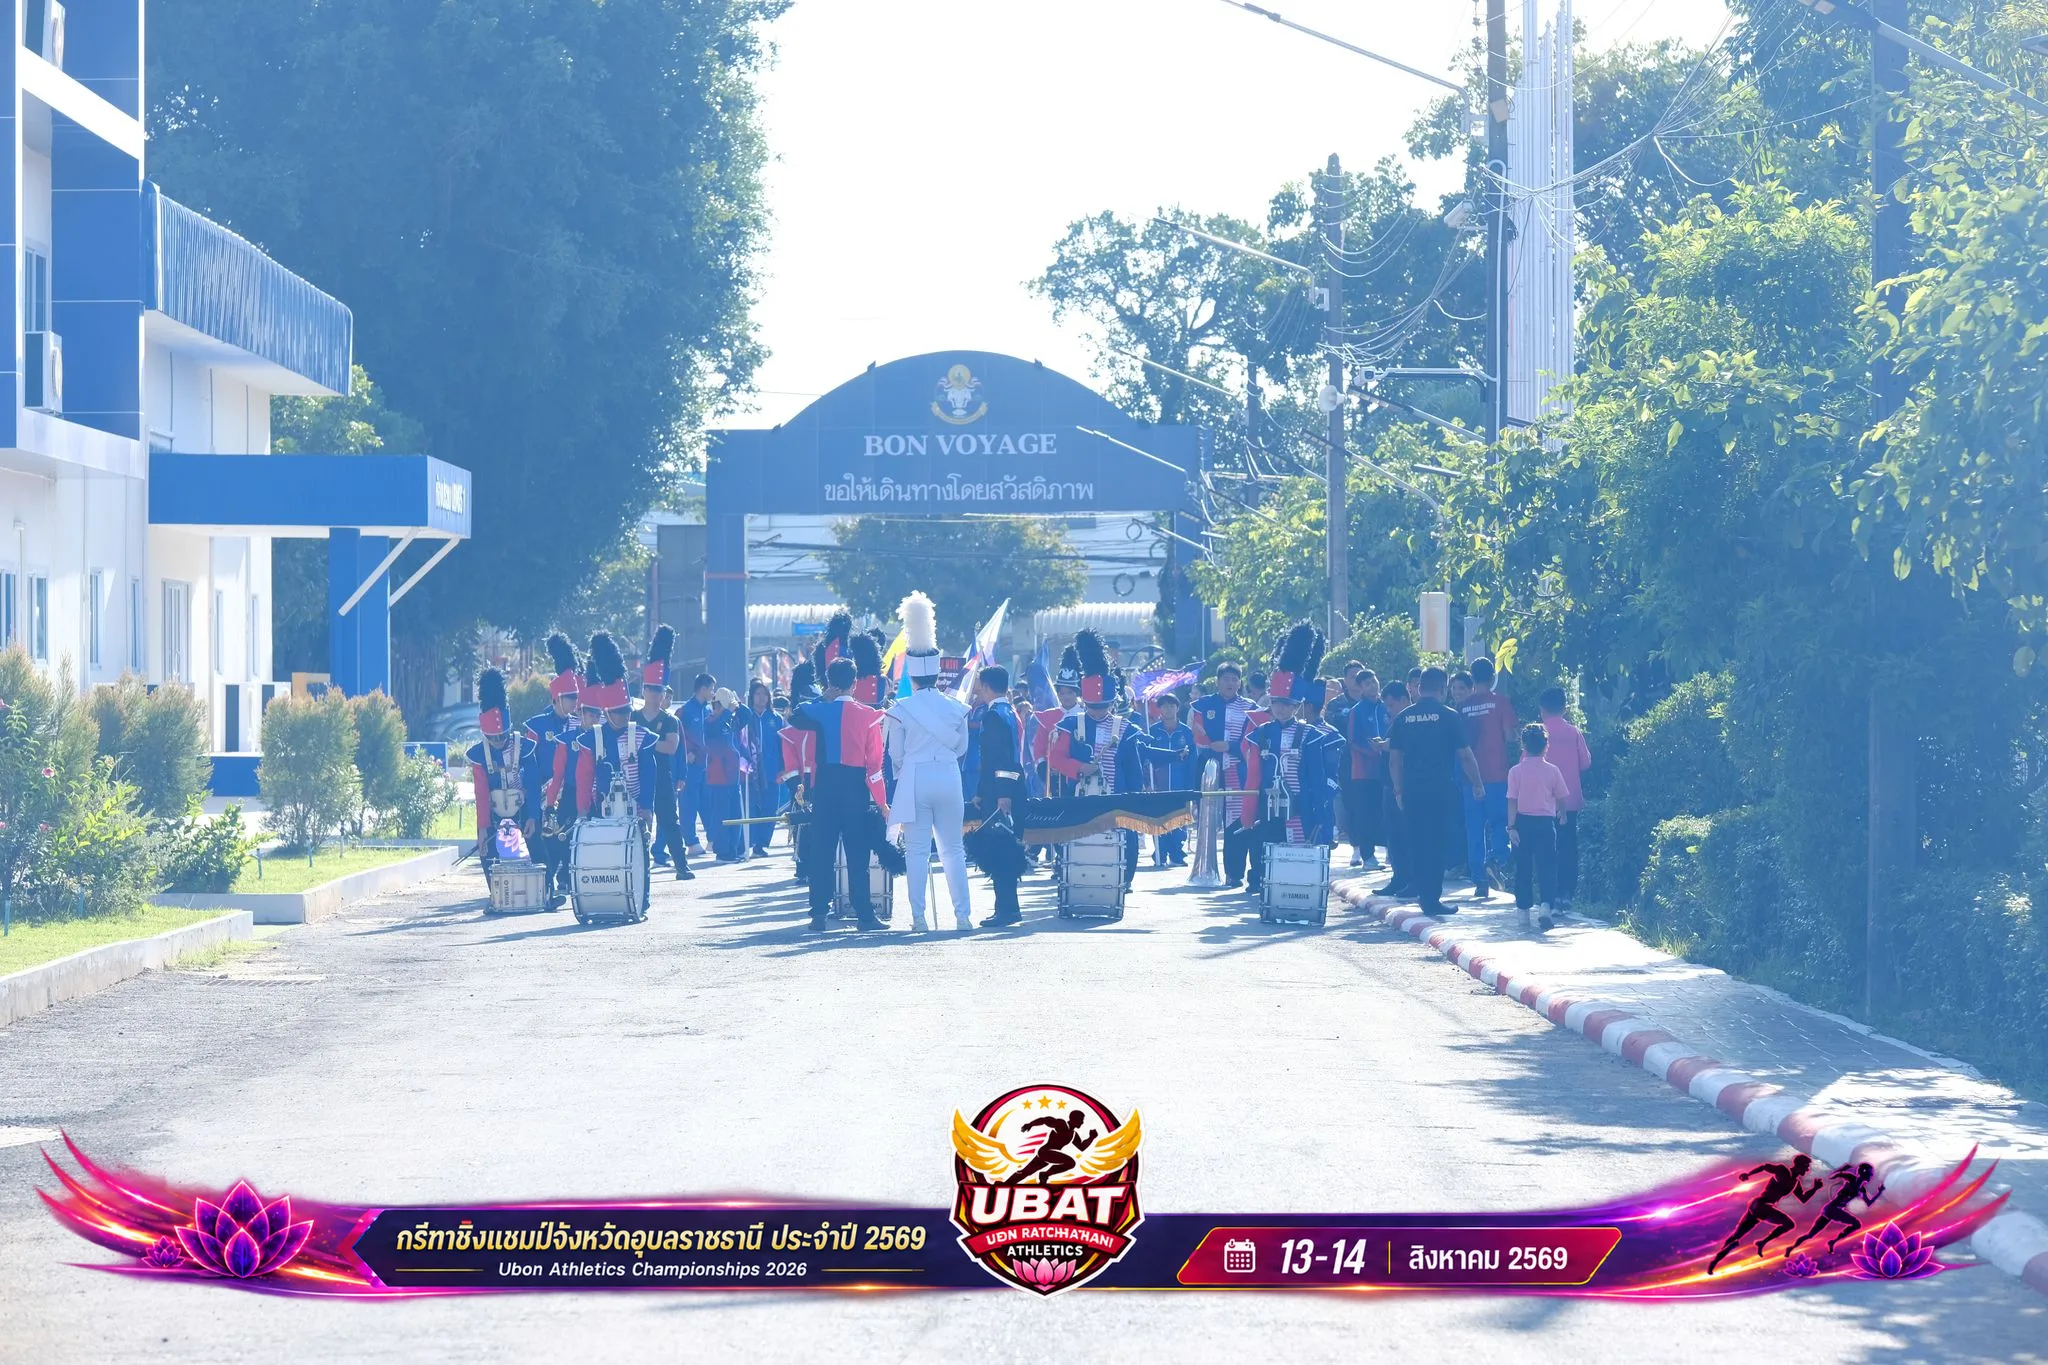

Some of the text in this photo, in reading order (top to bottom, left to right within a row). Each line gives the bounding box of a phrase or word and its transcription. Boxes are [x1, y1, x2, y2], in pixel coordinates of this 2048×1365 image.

[864, 433, 1057, 457] BON VOYAGE
[824, 473, 1094, 501] ขอให้เดินทางโดยสวัสดิภาพ
[590, 875, 620, 884] YAMAHA
